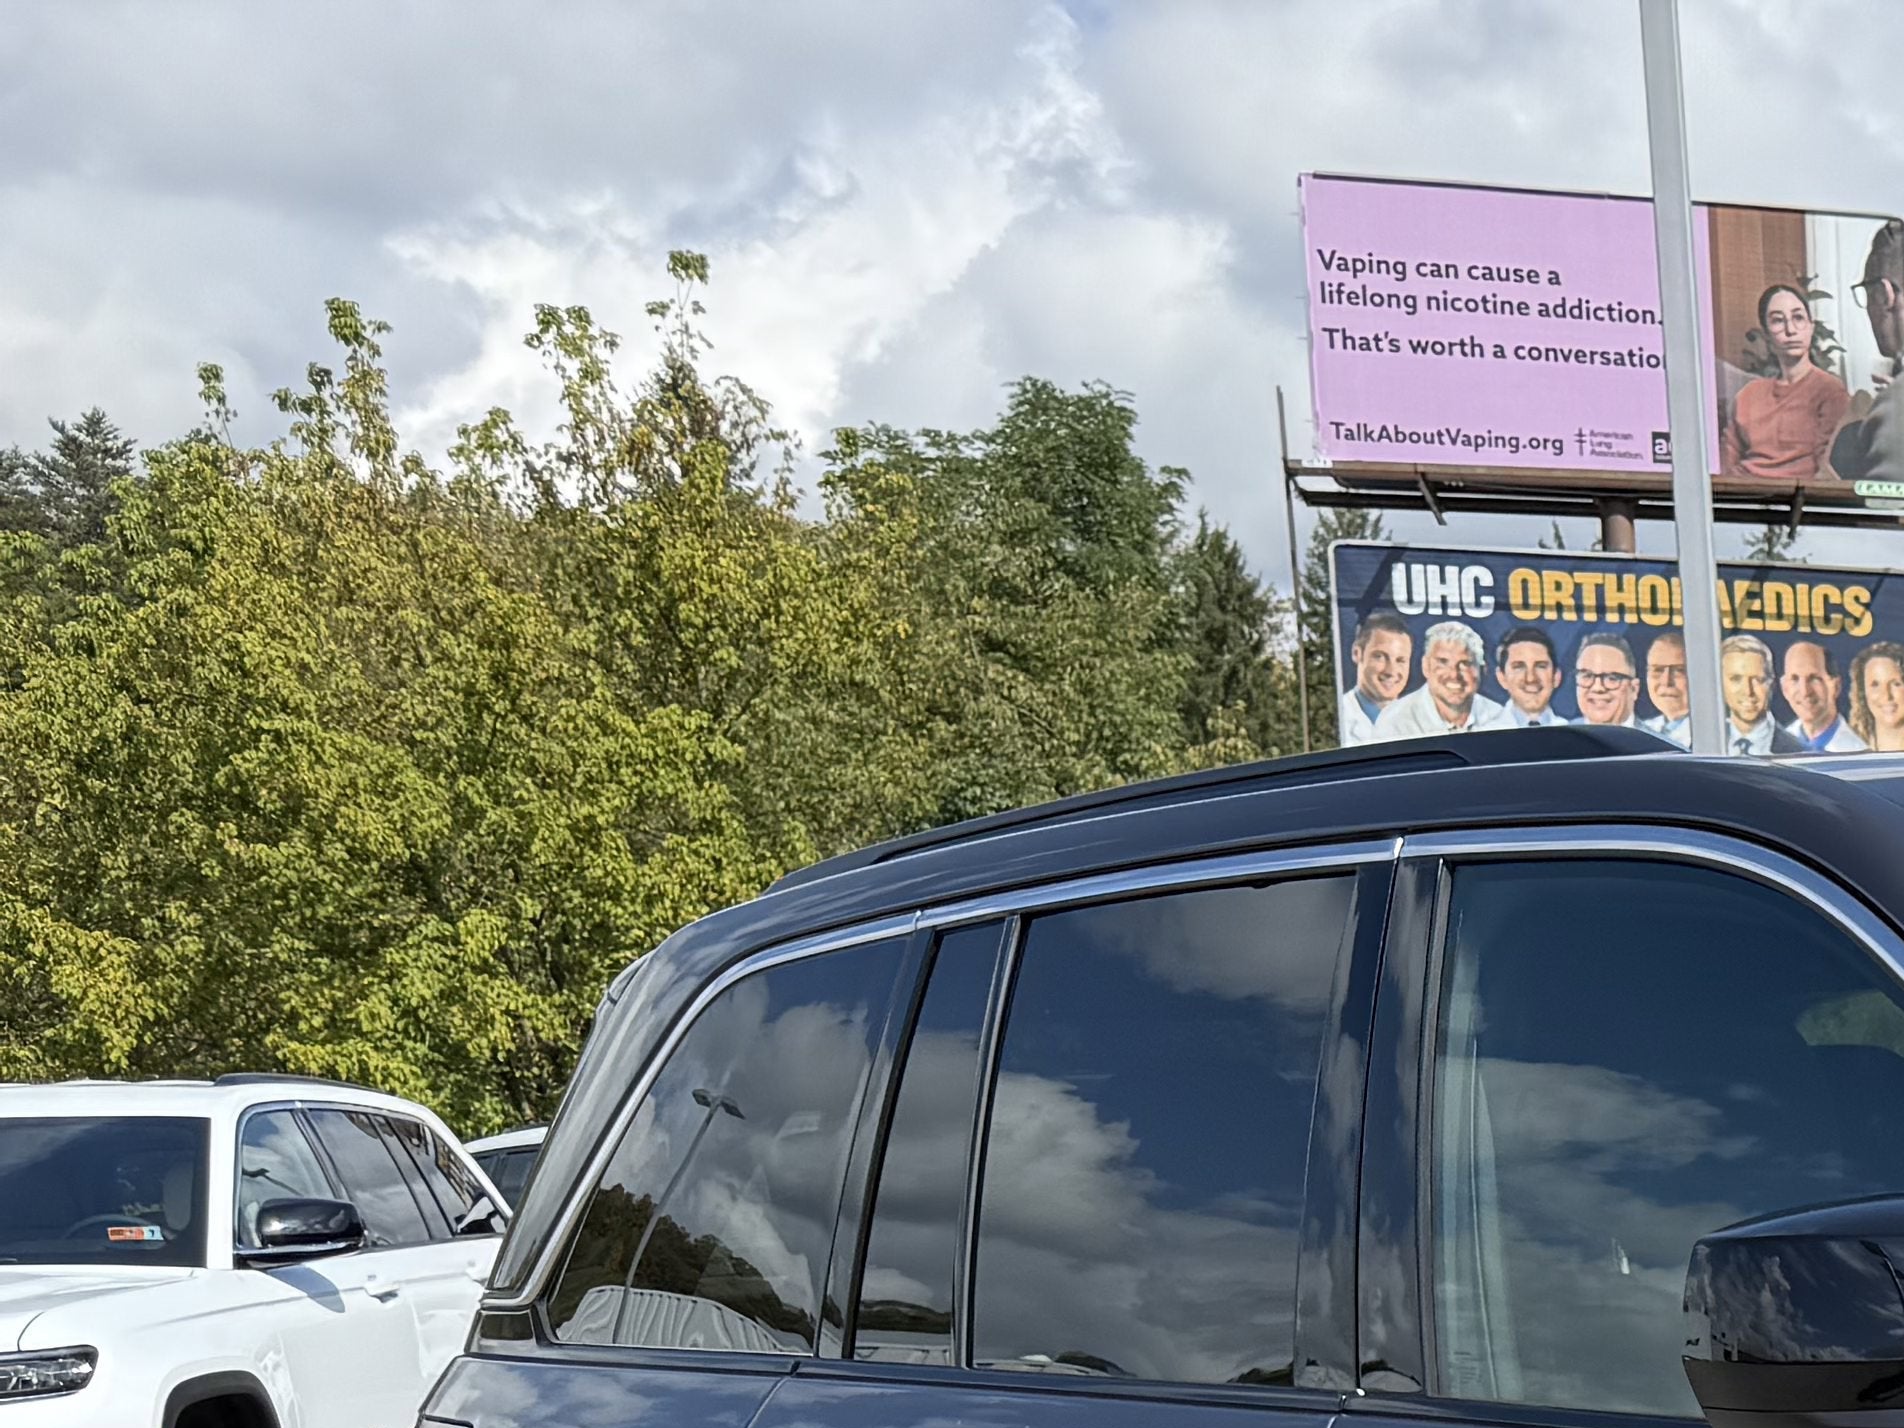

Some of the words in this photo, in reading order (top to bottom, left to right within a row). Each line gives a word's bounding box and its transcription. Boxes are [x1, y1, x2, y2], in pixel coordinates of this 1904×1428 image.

[1317, 249, 1407, 282] Vaping
[1415, 261, 1459, 279] can
[1467, 263, 1541, 285] cause
[1547, 269, 1562, 286] a
[1320, 281, 1418, 316] lifelong
[1426, 290, 1530, 317] nicotine
[1538, 297, 1663, 326] addiction.
[1408, 335, 1485, 358] worth
[1493, 343, 1506, 360] a
[1514, 344, 1666, 370] conversatio
[1329, 421, 1564, 457] TalkAboutVaping.org
[1391, 562, 1495, 619] UHC
[1508, 567, 1873, 637] ORTHOEDICS
